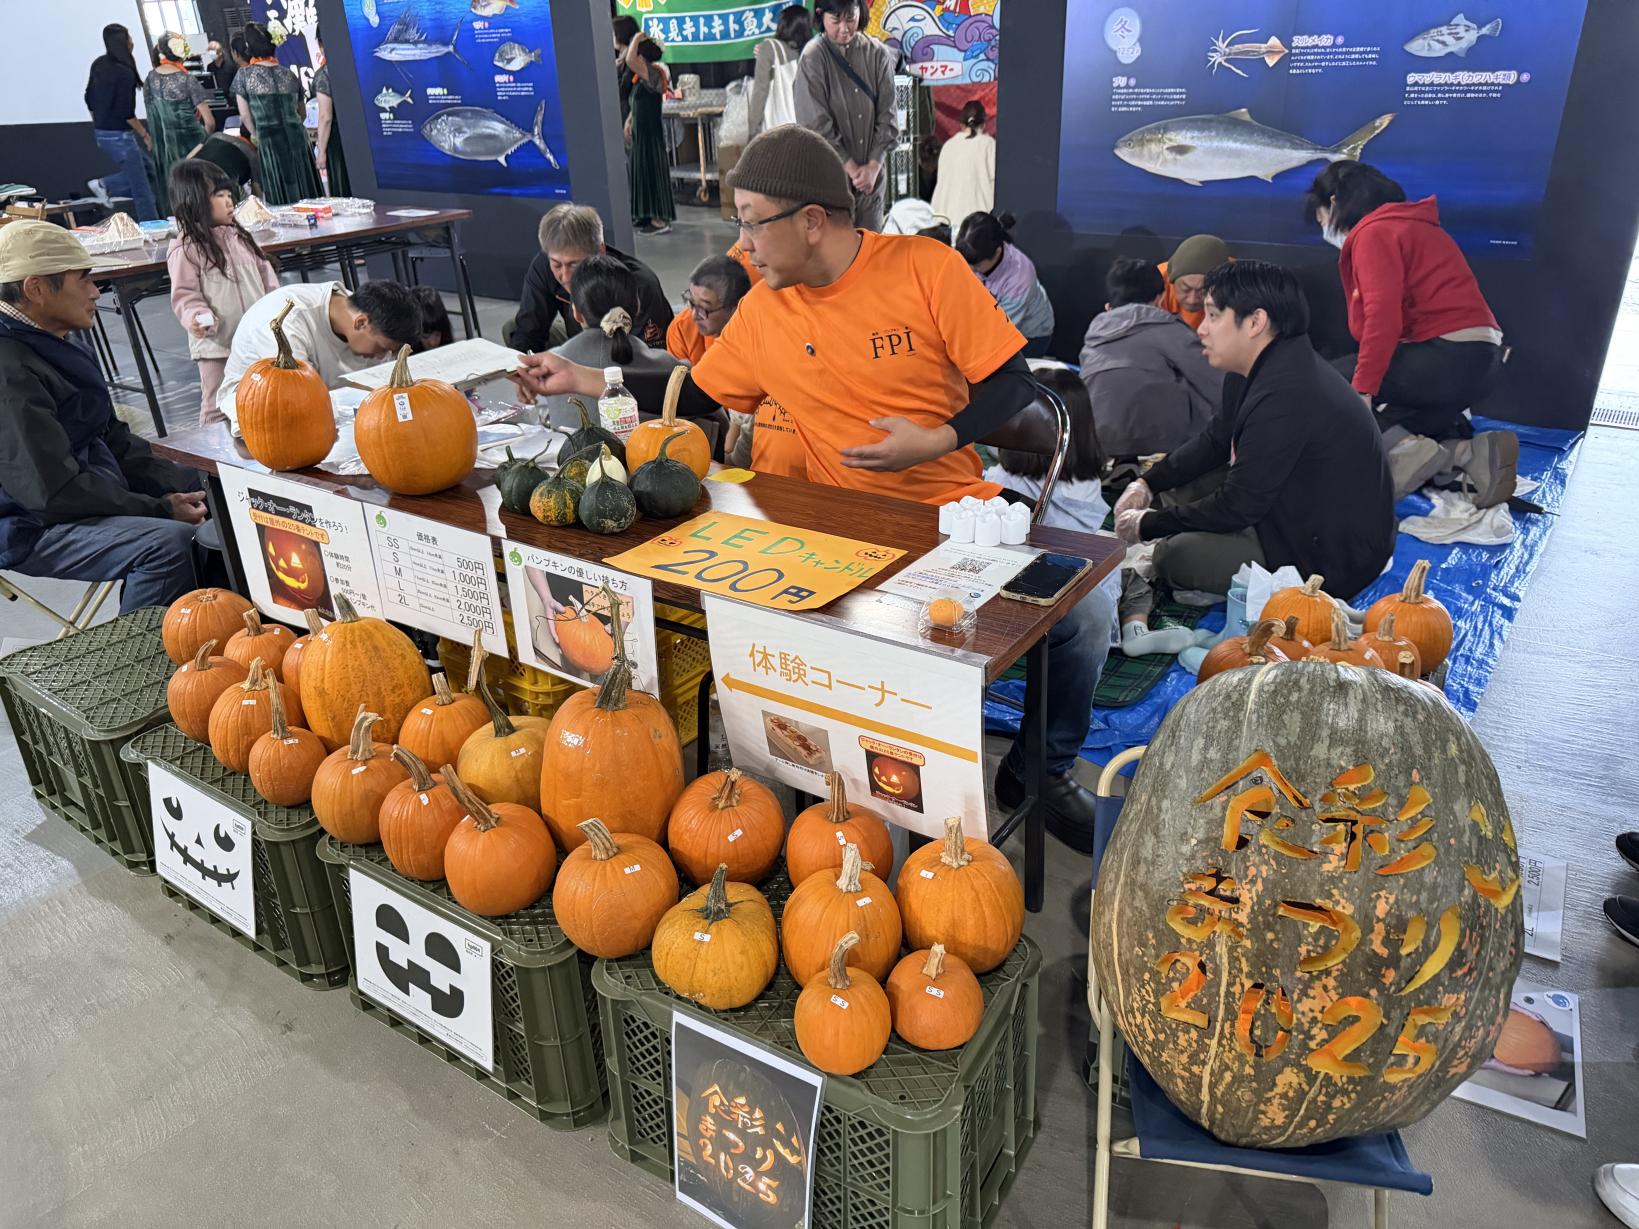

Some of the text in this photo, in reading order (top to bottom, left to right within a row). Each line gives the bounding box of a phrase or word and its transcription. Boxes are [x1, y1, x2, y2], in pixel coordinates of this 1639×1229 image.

[648, 5, 794, 42] 氷見キトキト魚大
[1112, 16, 1132, 39] 冬
[1292, 34, 1334, 47] スルメイカ
[919, 64, 954, 77] ヤンマー
[386, 536, 400, 549] SS
[416, 531, 438, 546] 価格表
[392, 552, 400, 563] S
[456, 556, 485, 576] 500円
[394, 566, 403, 577] M
[452, 570, 487, 590] 1,000円
[526, 554, 628, 591] パンプキンの優しい持ち方
[650, 548, 817, 605] 200円
[398, 580, 405, 591] L
[454, 585, 490, 606] 1,500円
[398, 593, 410, 606] 2L
[456, 599, 492, 620] 2,000円
[459, 613, 495, 635] 2,500円
[748, 642, 933, 711] 体験コーナー
[698, 933, 706, 941] S
[1166, 867, 1461, 996] まつり
[1156, 951, 1454, 1083] 2025
[698, 1138, 780, 1205] 2025
